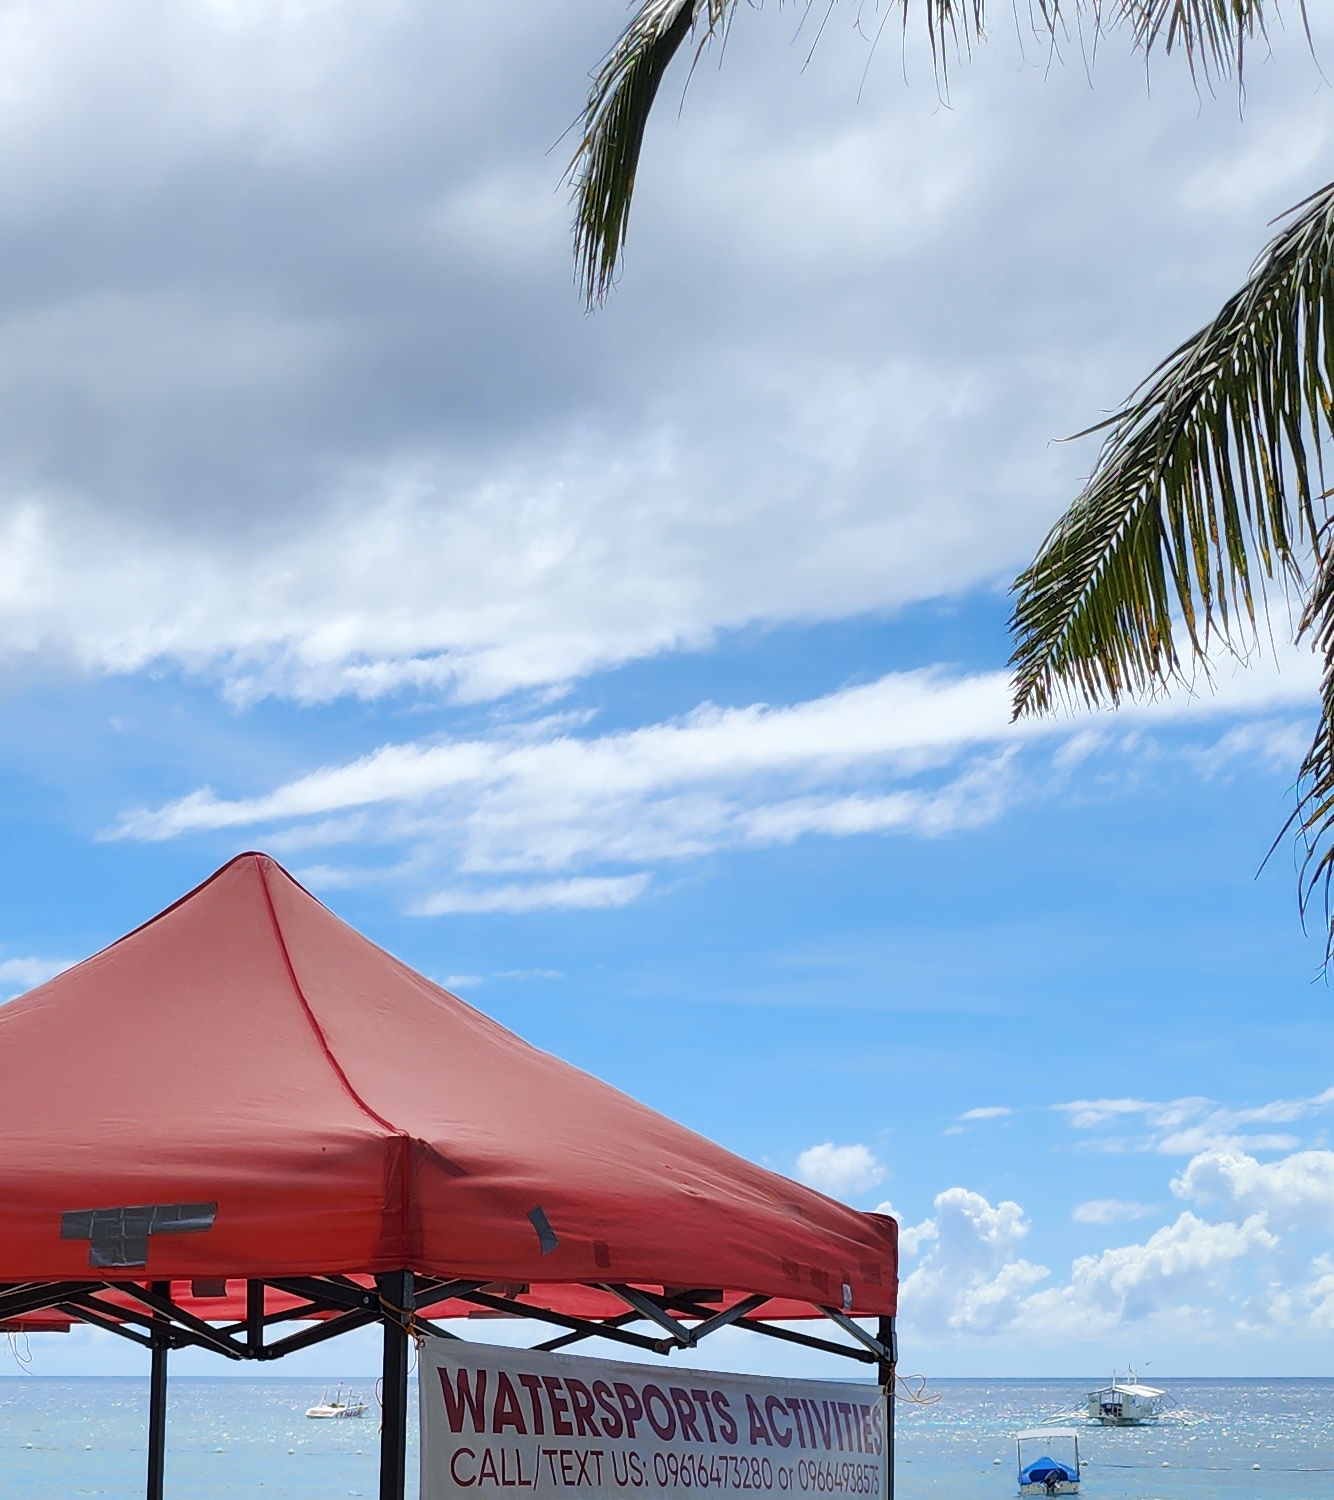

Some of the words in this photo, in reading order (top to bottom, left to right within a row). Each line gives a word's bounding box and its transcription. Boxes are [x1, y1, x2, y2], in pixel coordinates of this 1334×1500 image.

[437, 1367, 737, 1446] WATERSPORTS
[745, 1394, 884, 1456] ACTIVITIES
[450, 1445, 603, 1491] CALL/TEXT
[612, 1450, 648, 1488] US:
[653, 1453, 773, 1490] 09616473280
[778, 1466, 793, 1490] or
